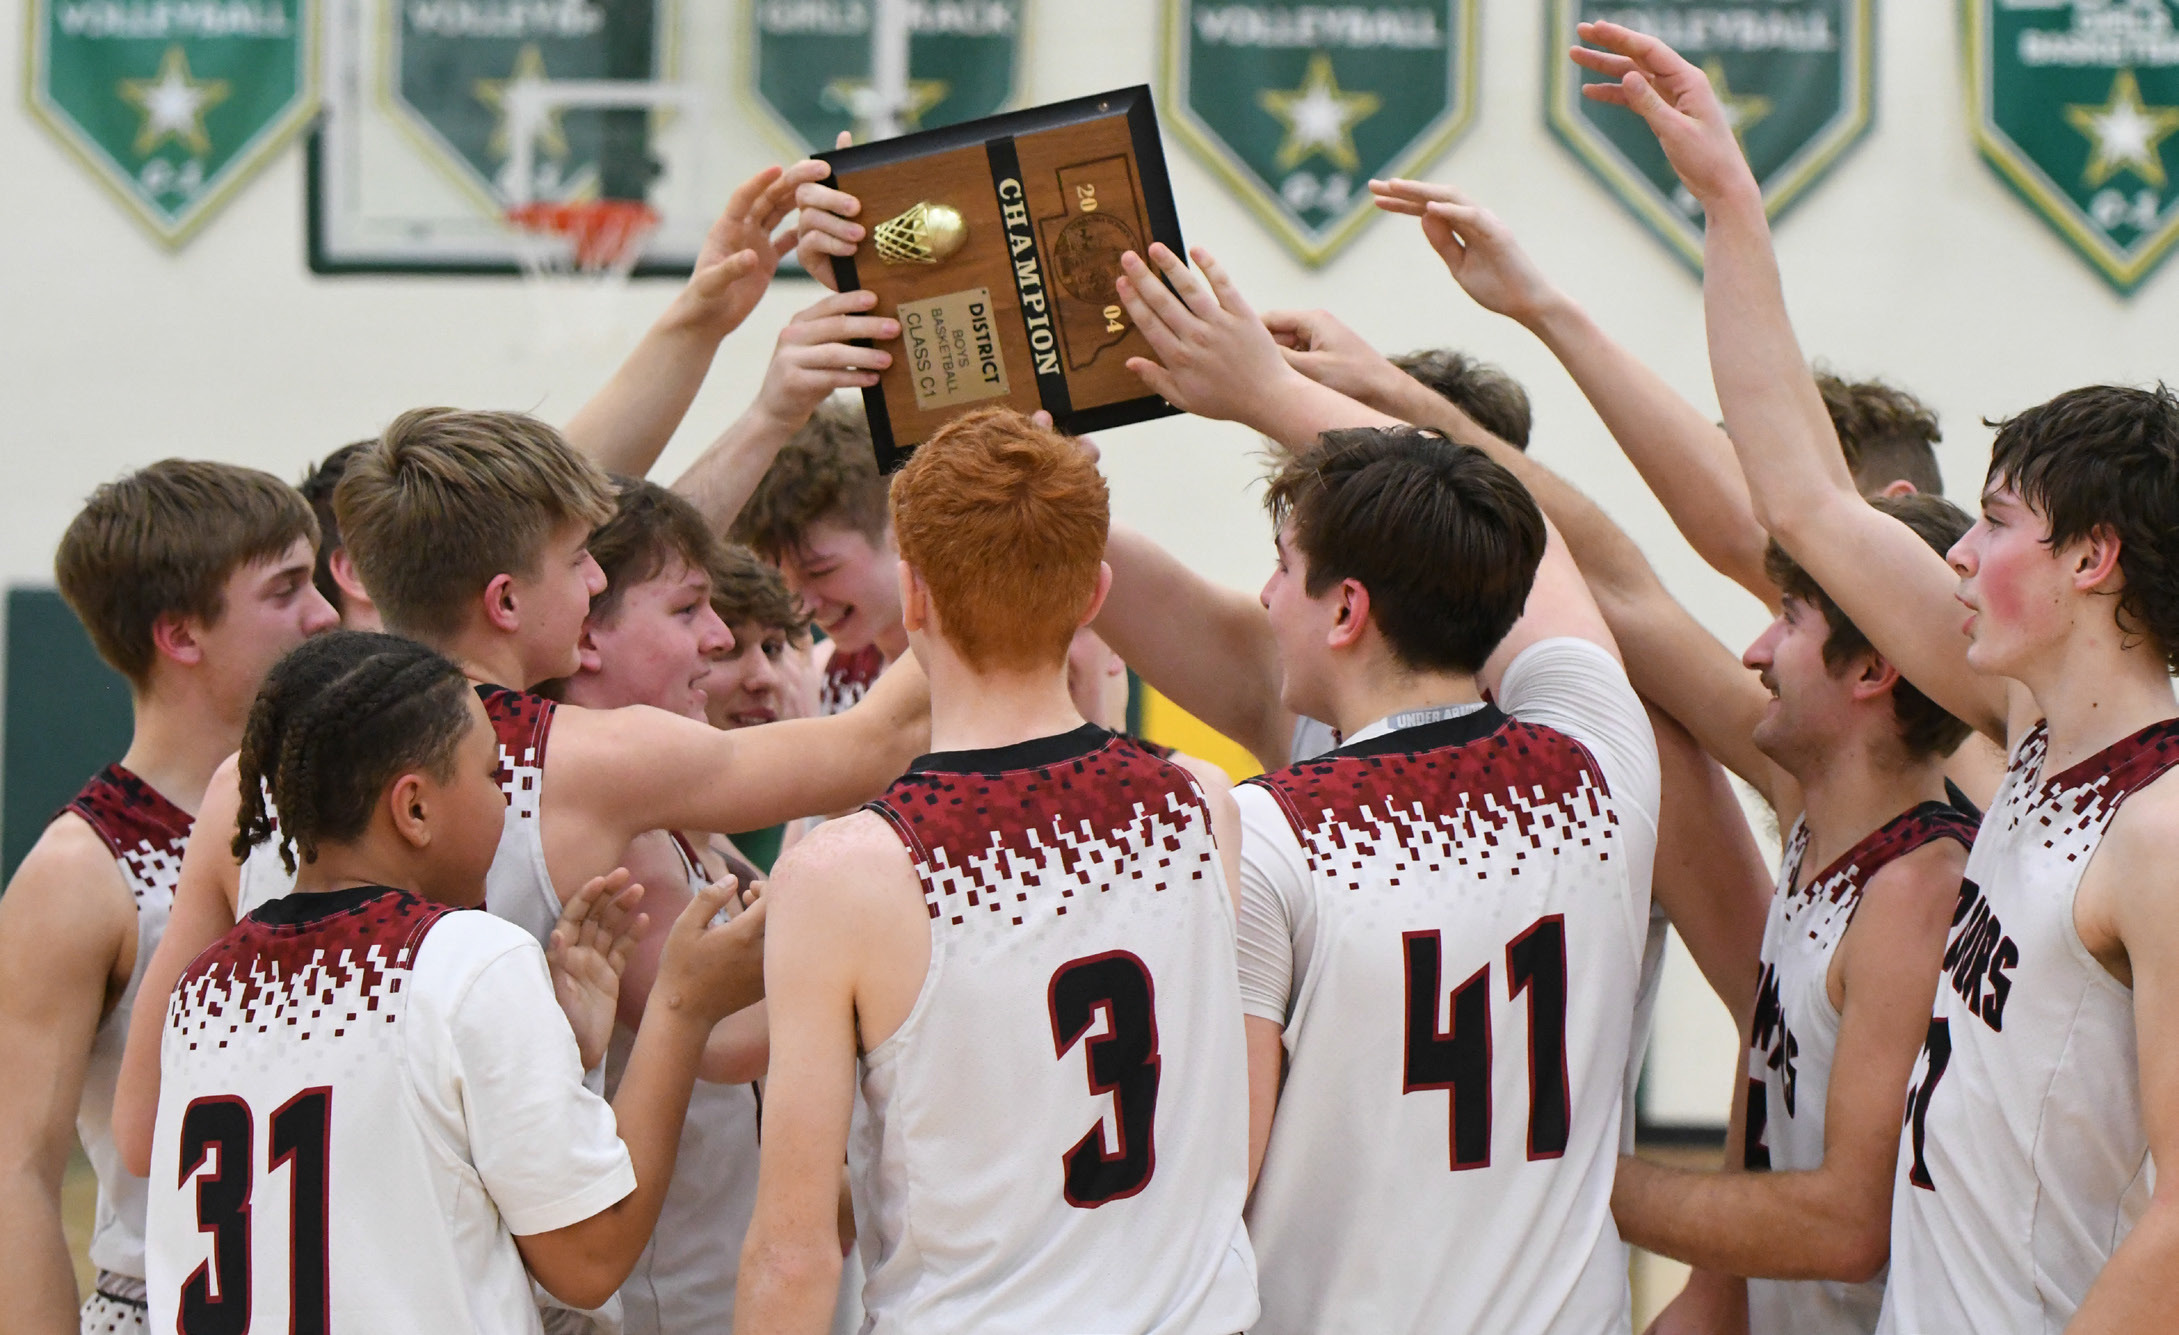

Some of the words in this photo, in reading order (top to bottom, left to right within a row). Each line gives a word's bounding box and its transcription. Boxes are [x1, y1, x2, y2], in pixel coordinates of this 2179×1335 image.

[896, 1, 1014, 36] RACK
[1195, 7, 1443, 48] VOLLEYBALL
[1076, 183, 1098, 213] 20
[999, 178, 1060, 376] CHAMPION
[907, 312, 932, 372] CLASS
[920, 376, 937, 398] C1
[931, 308, 959, 395] BASKETBALL
[952, 329, 970, 368] BOYS
[968, 302, 1000, 384] DISTRICT
[1103, 304, 1125, 334] 04
[1396, 710, 1441, 728] UNDER
[1047, 949, 1162, 1210] 3
[1402, 913, 1571, 1172] 41
[176, 1085, 333, 1335] 31
